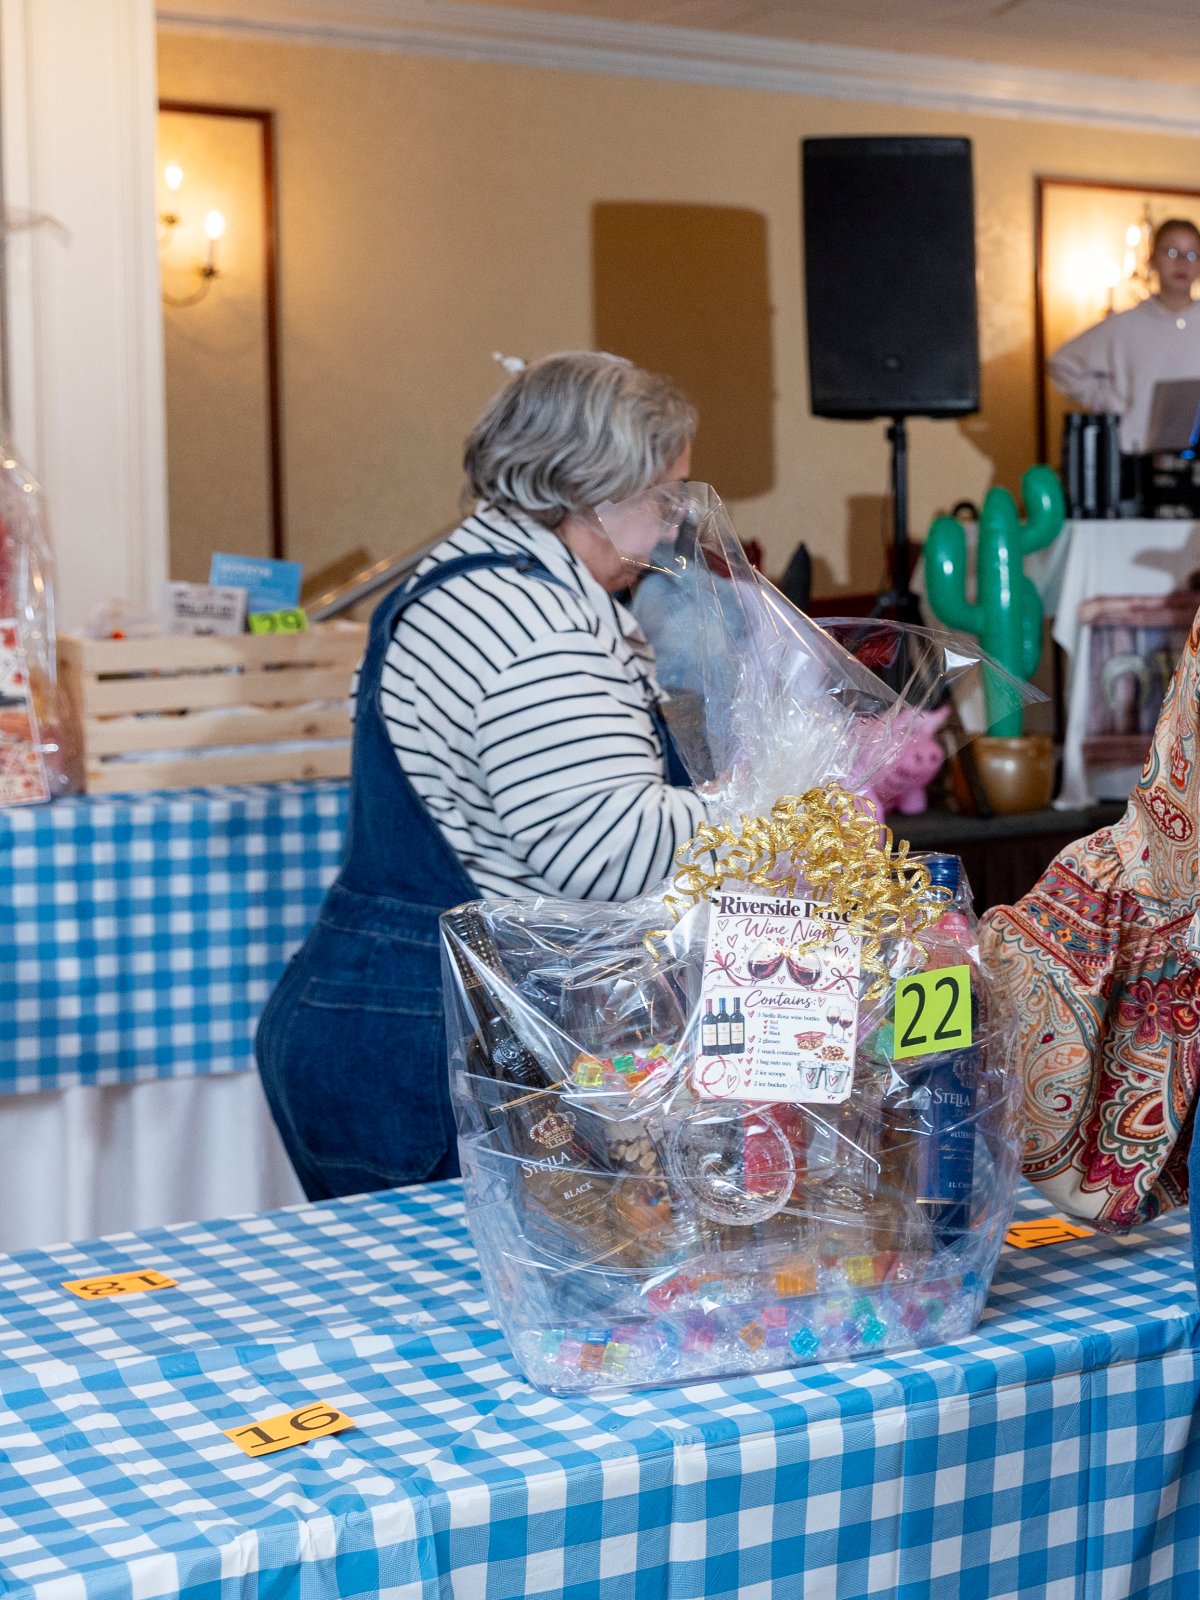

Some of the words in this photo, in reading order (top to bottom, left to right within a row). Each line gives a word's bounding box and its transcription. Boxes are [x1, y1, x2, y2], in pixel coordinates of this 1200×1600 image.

[719, 895, 800, 917] Riverside
[736, 918, 789, 938] Wine
[744, 989, 816, 1008] Contains:
[900, 976, 962, 1048] 22
[934, 1087, 970, 1107] STELLA
[521, 1152, 572, 1179] STELLA
[563, 1181, 593, 1200] BLACK
[236, 1406, 340, 1448] 16
